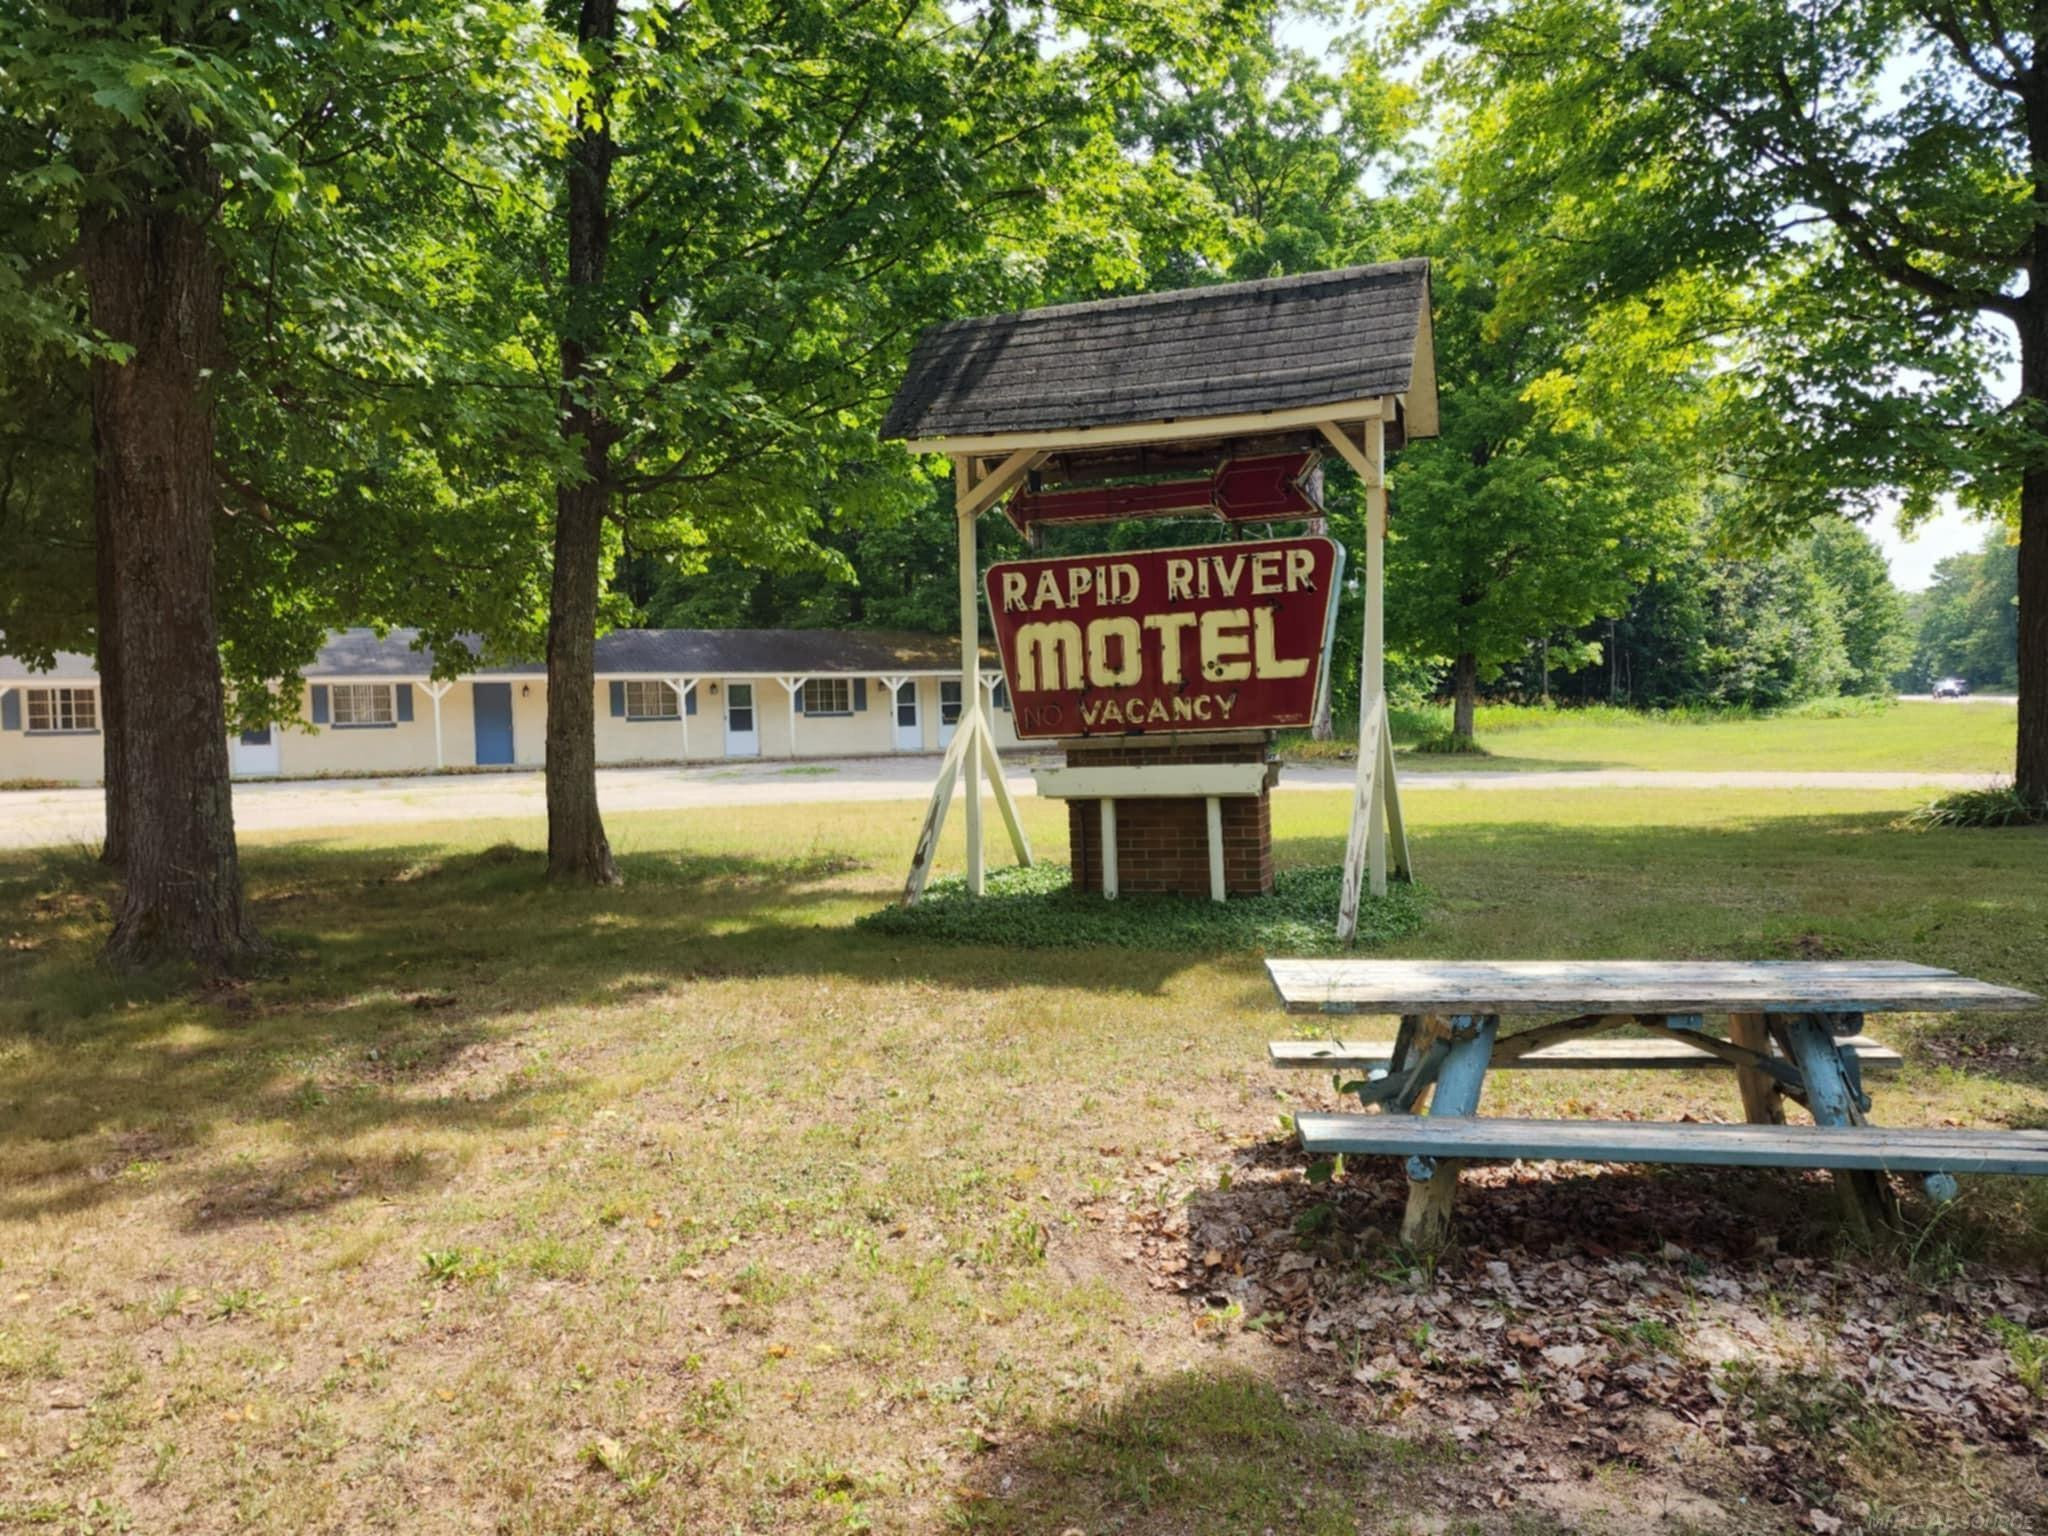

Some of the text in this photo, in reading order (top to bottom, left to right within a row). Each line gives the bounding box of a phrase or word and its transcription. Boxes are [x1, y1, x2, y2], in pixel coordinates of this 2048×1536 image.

[1002, 549, 1317, 614] RAPID RIVER
[1015, 606, 1310, 693] MOTEL
[1023, 694, 1237, 729] NO VACANCY
